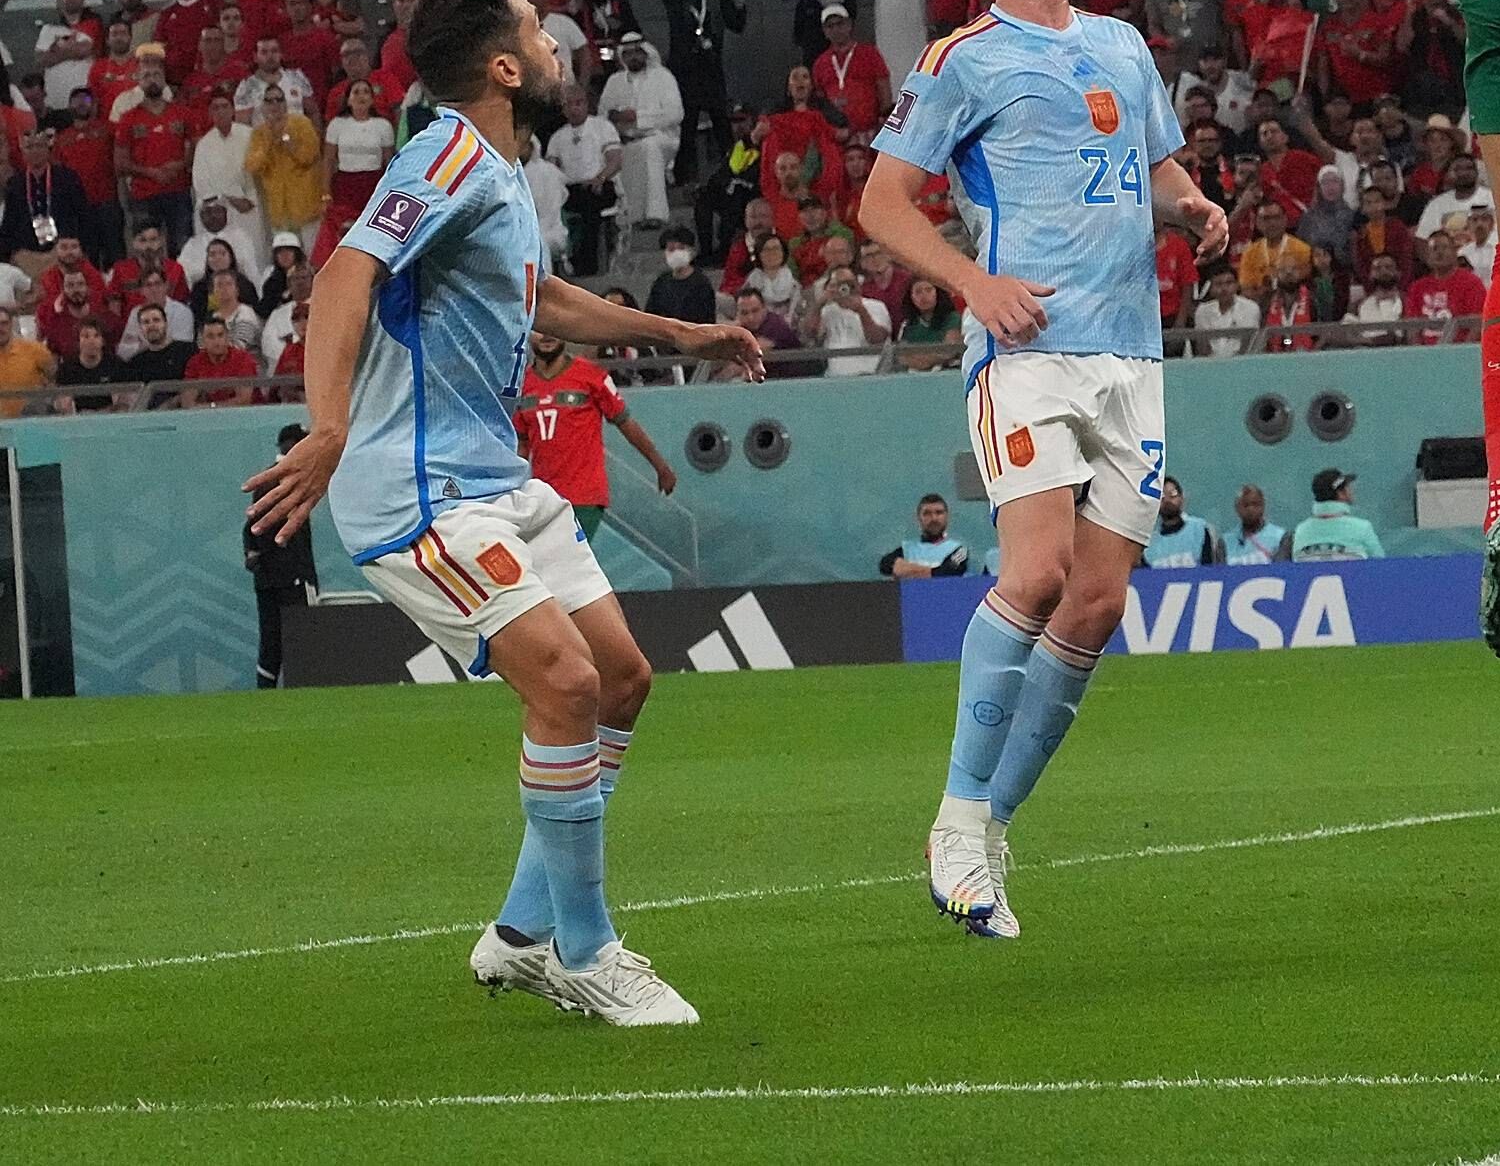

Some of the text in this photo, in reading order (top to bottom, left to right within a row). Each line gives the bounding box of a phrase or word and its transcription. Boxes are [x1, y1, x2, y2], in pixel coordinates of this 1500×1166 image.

[1077, 146, 1144, 207] 24
[536, 408, 558, 441] 17
[1122, 575, 1357, 654] VISA
